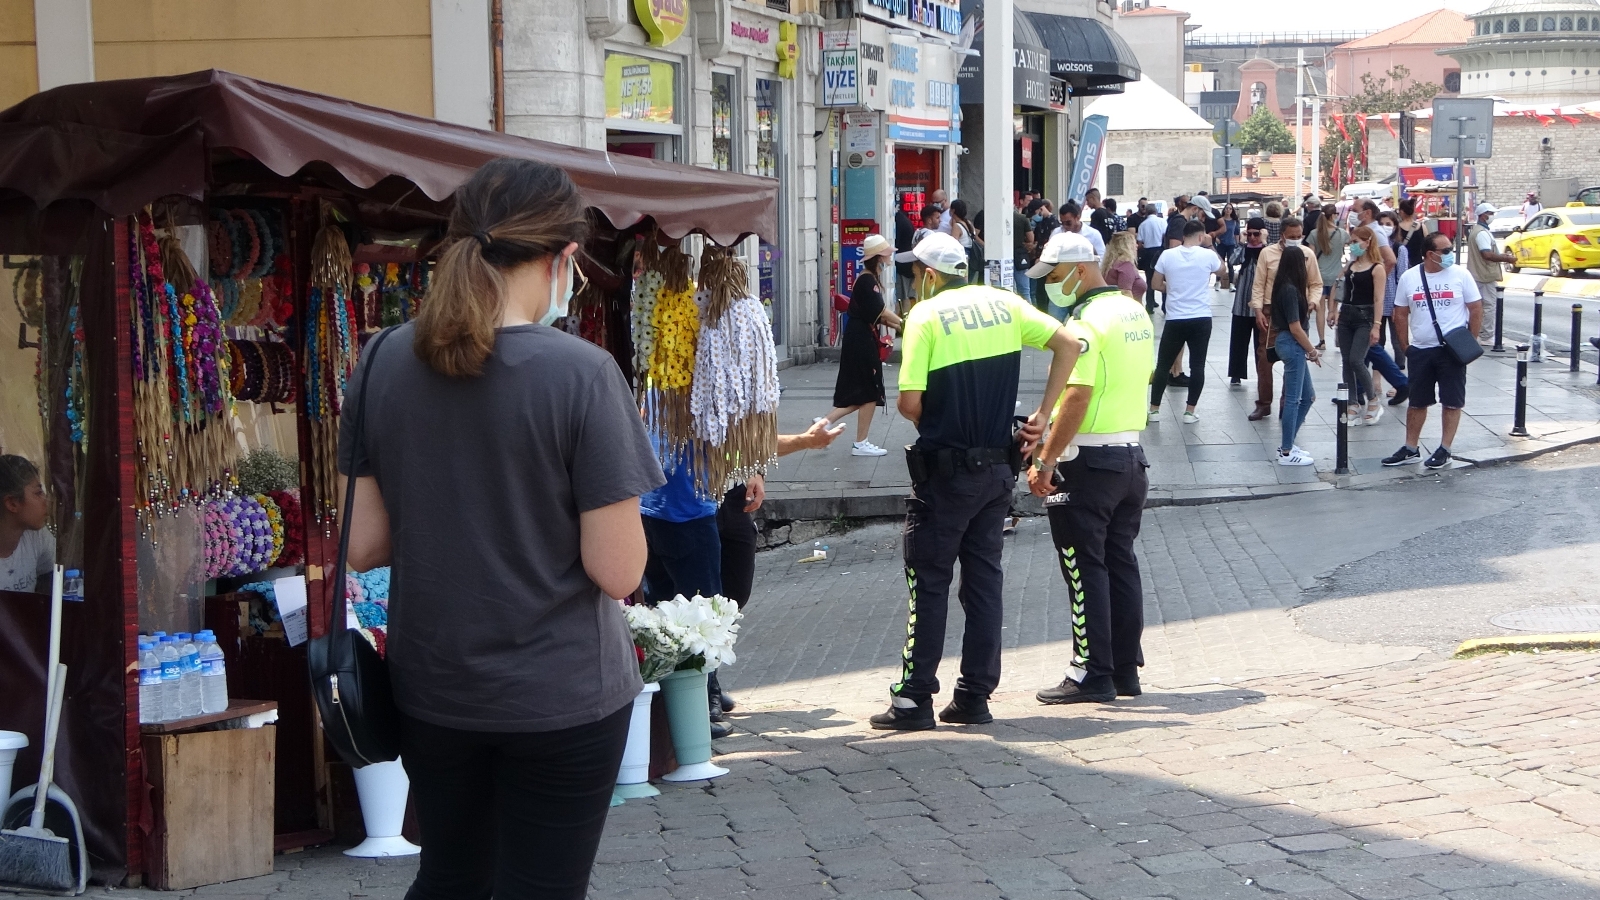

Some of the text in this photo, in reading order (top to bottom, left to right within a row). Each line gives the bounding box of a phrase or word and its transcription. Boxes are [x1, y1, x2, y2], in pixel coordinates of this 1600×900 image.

[826, 55, 855, 66] TAKSİM
[1057, 62, 1093, 72] watsons
[826, 70, 855, 88] VİZE
[1025, 79, 1046, 102] HOTEL
[1415, 299, 1451, 308] RAING
